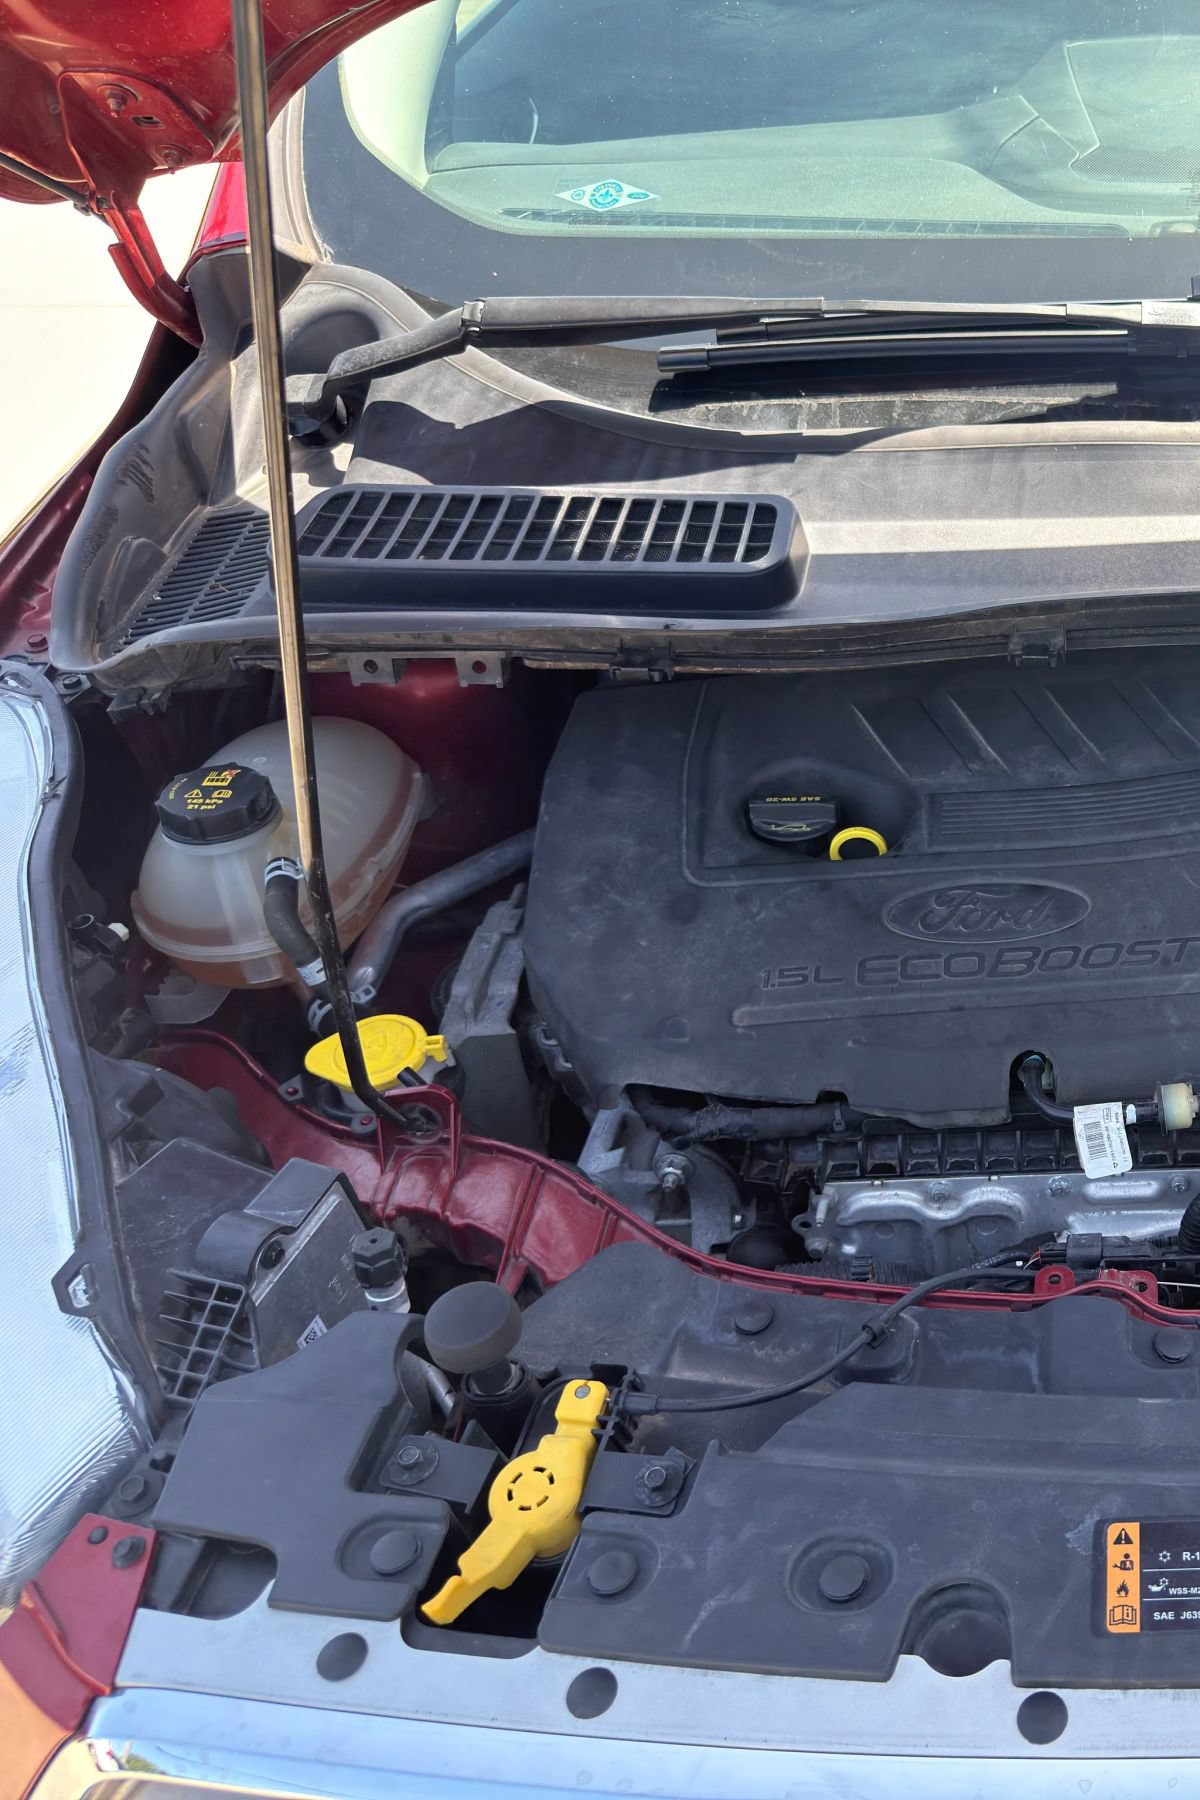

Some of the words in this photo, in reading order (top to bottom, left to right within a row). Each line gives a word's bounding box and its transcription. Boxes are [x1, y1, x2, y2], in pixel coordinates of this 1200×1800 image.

[914, 887, 1060, 935] Ford
[761, 965, 845, 989] 1.5L
[1153, 1611, 1175, 1620] SAE
